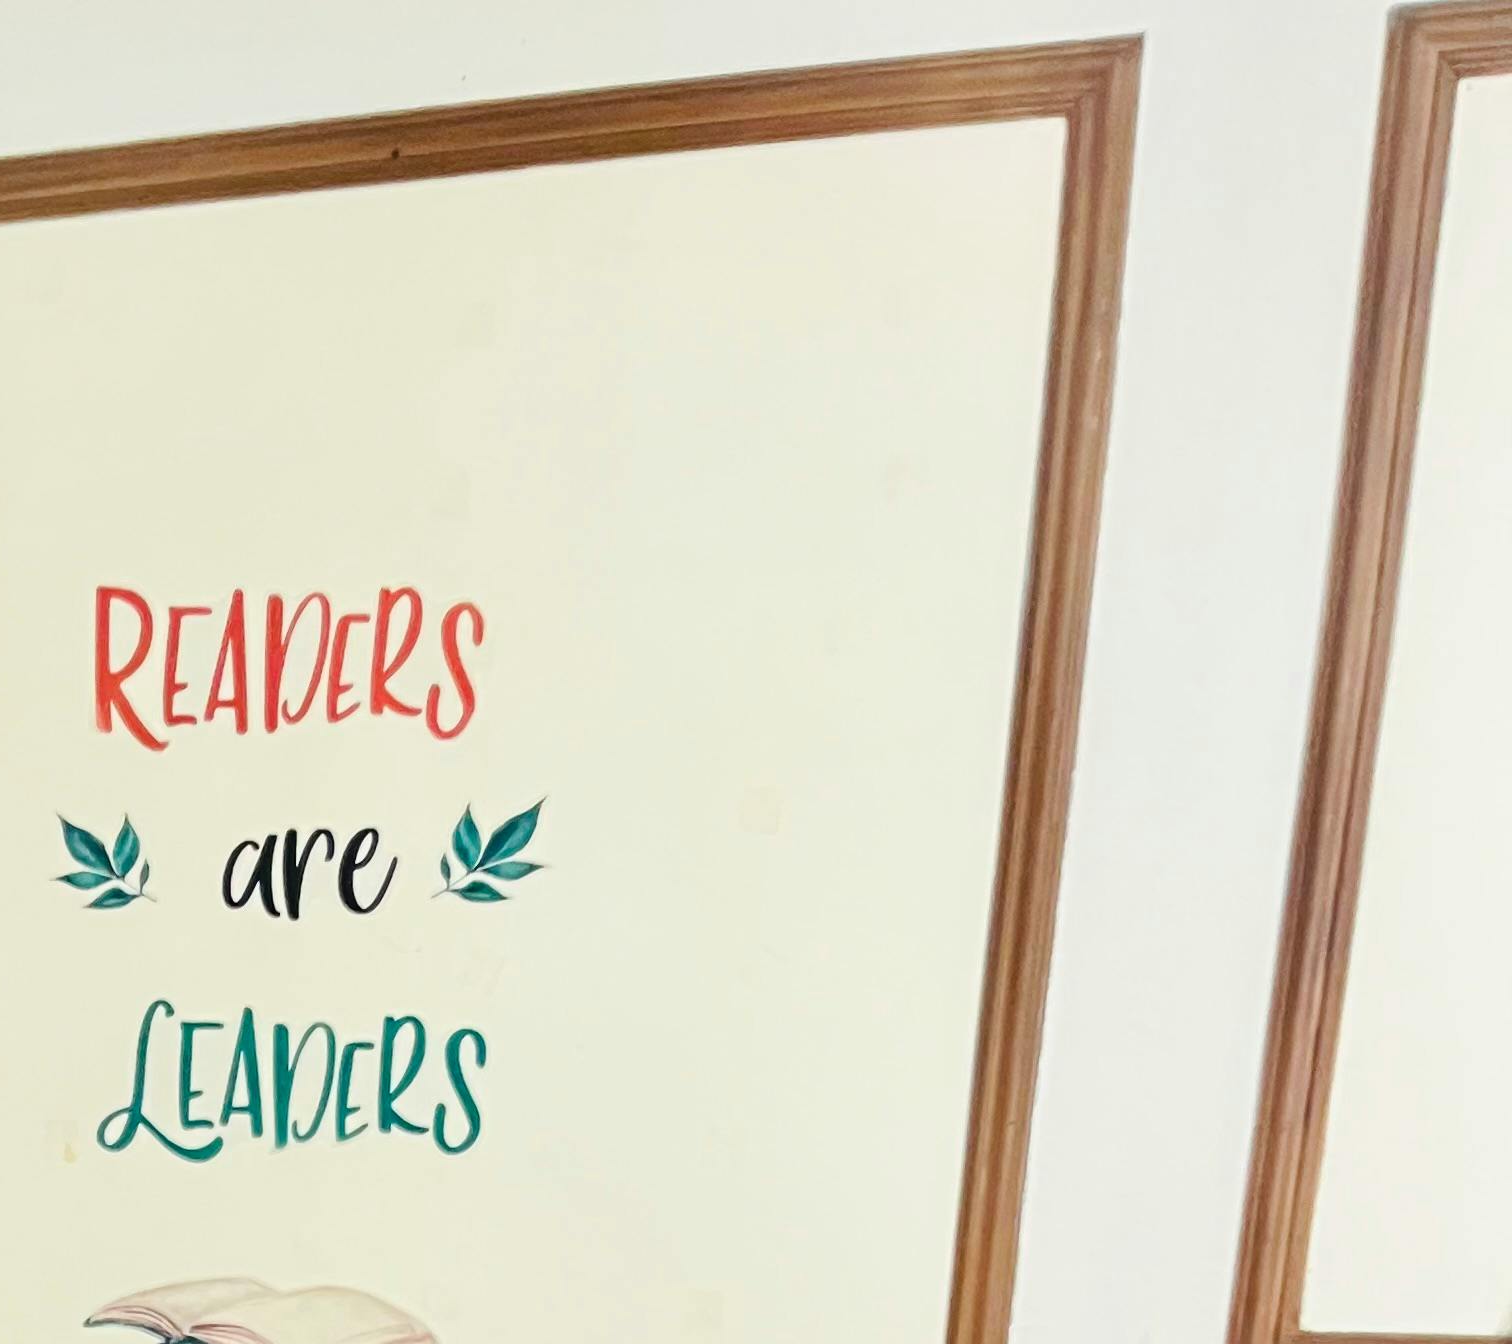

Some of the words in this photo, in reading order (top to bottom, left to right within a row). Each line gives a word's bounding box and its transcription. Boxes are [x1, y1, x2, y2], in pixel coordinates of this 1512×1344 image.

[93, 585, 485, 752] READERS
[221, 827, 399, 922] are
[96, 999, 487, 1163] LEADERS
